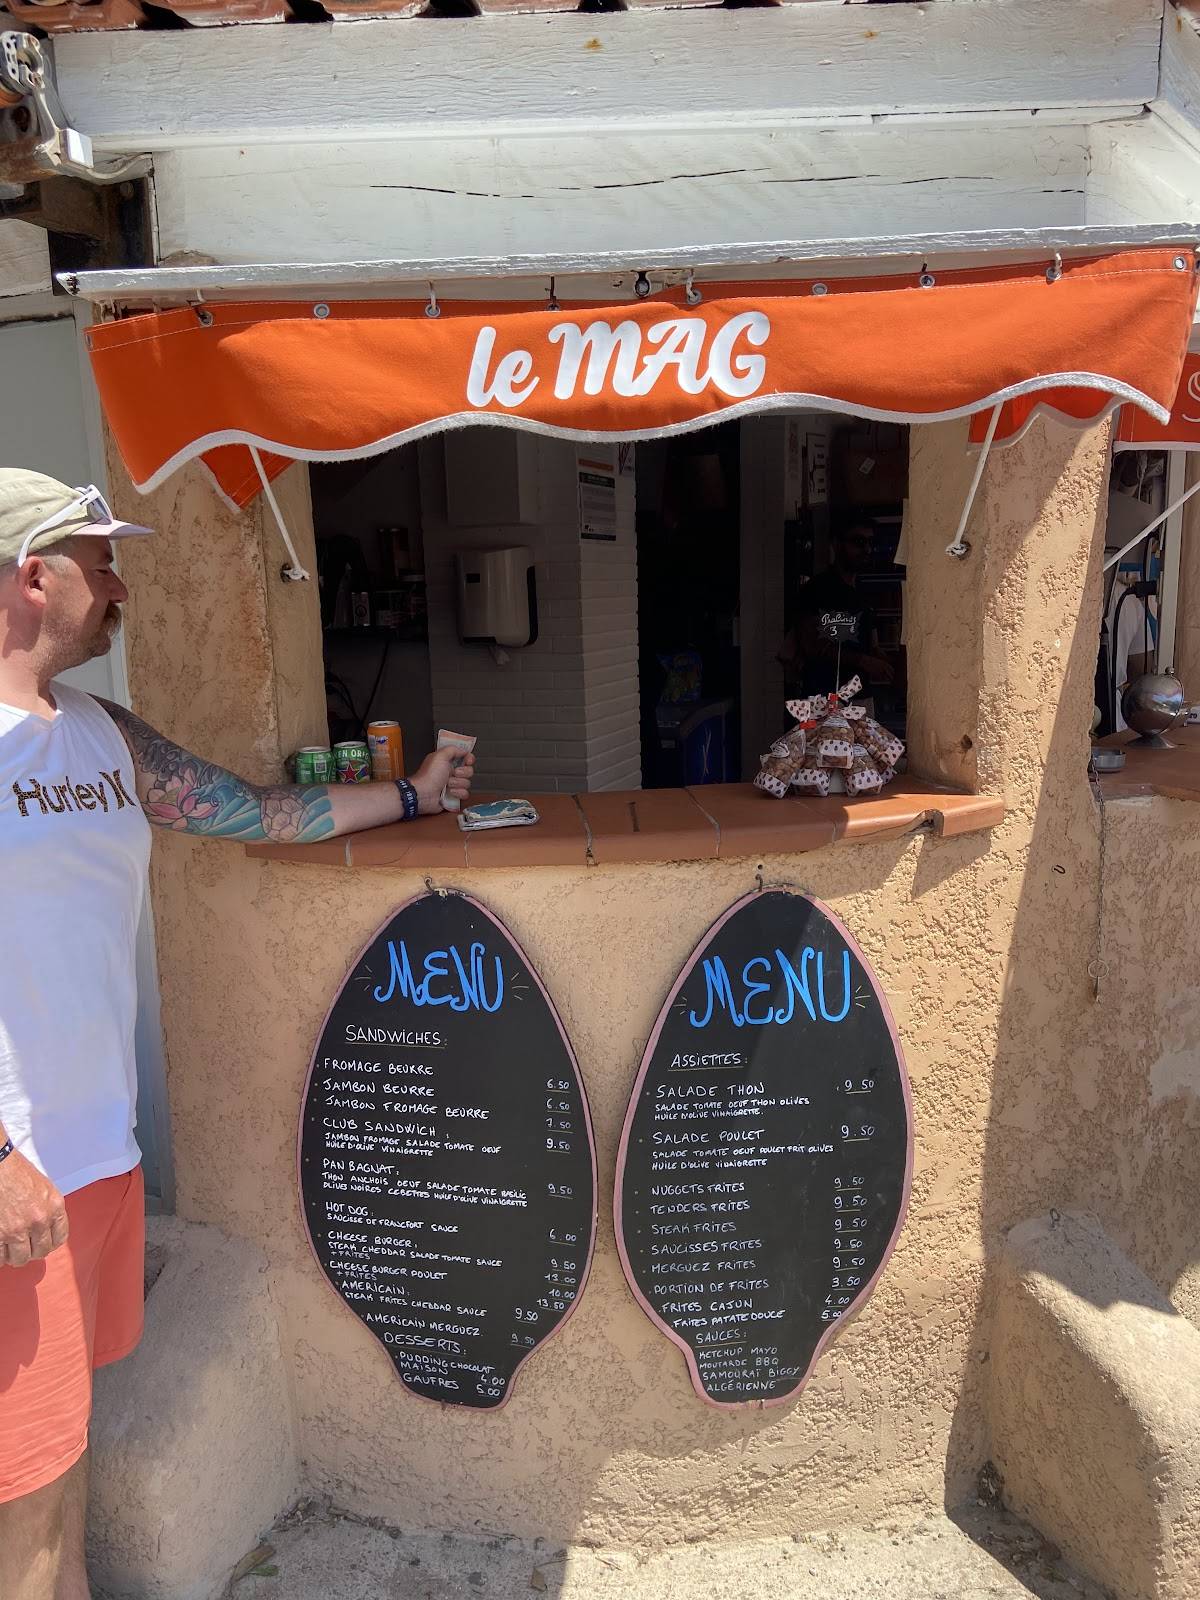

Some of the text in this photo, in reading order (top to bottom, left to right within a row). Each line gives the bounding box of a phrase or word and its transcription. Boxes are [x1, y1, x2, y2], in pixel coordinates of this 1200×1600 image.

[467, 311, 770, 407] le MAG
[830, 625, 838, 636] 3
[12, 776, 109, 817] Hurley
[373, 940, 504, 1013] MENU
[689, 947, 851, 1028] MENU
[323, 1057, 434, 1075] FROMAGE BEURRE
[322, 1078, 435, 1097] JAMBON BEURRE
[546, 1078, 570, 1090] 6.50
[656, 1081, 765, 1098] SALADE THON
[325, 1094, 490, 1120] JAMBON FROMAGE BEURRE
[655, 1102, 689, 1112] SALADE
[693, 1101, 722, 1111] TOMATE
[728, 1099, 748, 1109] OEUF
[751, 1098, 775, 1107] THON
[323, 1117, 358, 1130] CLUB
[653, 1125, 875, 1144] SALADE POULET 9.50
[325, 1132, 502, 1154] JAMBON FROMAGE SALADE TOMATE OEUF
[546, 1138, 571, 1151] 9.50
[653, 1149, 688, 1159] SALADE
[693, 1147, 729, 1157] TOMATE
[733, 1146, 755, 1155] OEUF
[760, 1145, 785, 1154] POULET
[323, 1157, 345, 1171] PAN
[322, 1171, 344, 1182] THON
[397, 1179, 421, 1188] OEUF
[426, 1181, 461, 1192] SALADE
[462, 1185, 497, 1196] TOMATE
[547, 1183, 573, 1195] 9.50
[651, 1184, 704, 1196] NUGGETS
[834, 1177, 865, 1189] 9.50
[325, 1200, 345, 1213] HOT
[650, 1202, 707, 1215] TENDERS
[834, 1195, 867, 1209] 9.50
[366, 1217, 377, 1226] DE
[378, 1218, 425, 1229] FRANCFORT
[430, 1222, 460, 1233] SAUCE
[651, 1223, 690, 1235] STEAK
[327, 1230, 369, 1243] CHEESE
[328, 1241, 502, 1267] STEAK CHEDDAR SALADE TOMATE SAUCE
[329, 1260, 448, 1280] CHEESE BURGER POULET
[651, 1262, 710, 1274] MERGUEZ
[832, 1256, 866, 1269] 9.50
[709, 1282, 724, 1292] DE
[831, 1276, 861, 1288] 3.50
[344, 1291, 374, 1302] STEAK
[411, 1300, 452, 1312] CHEDDAR
[456, 1306, 488, 1317] SAUCE
[710, 1298, 753, 1311] CAJUN
[825, 1294, 850, 1305] 4.00
[515, 1307, 539, 1321] 9.50
[711, 1312, 749, 1325] PATATE
[750, 1309, 786, 1321] DOUCE
[700, 1347, 778, 1359] KETCHUP MAYO
[450, 1361, 495, 1374] CHOCOLAT
[700, 1357, 779, 1369] MOUTARDE BBQ
[403, 1372, 459, 1390] GAUFRES
